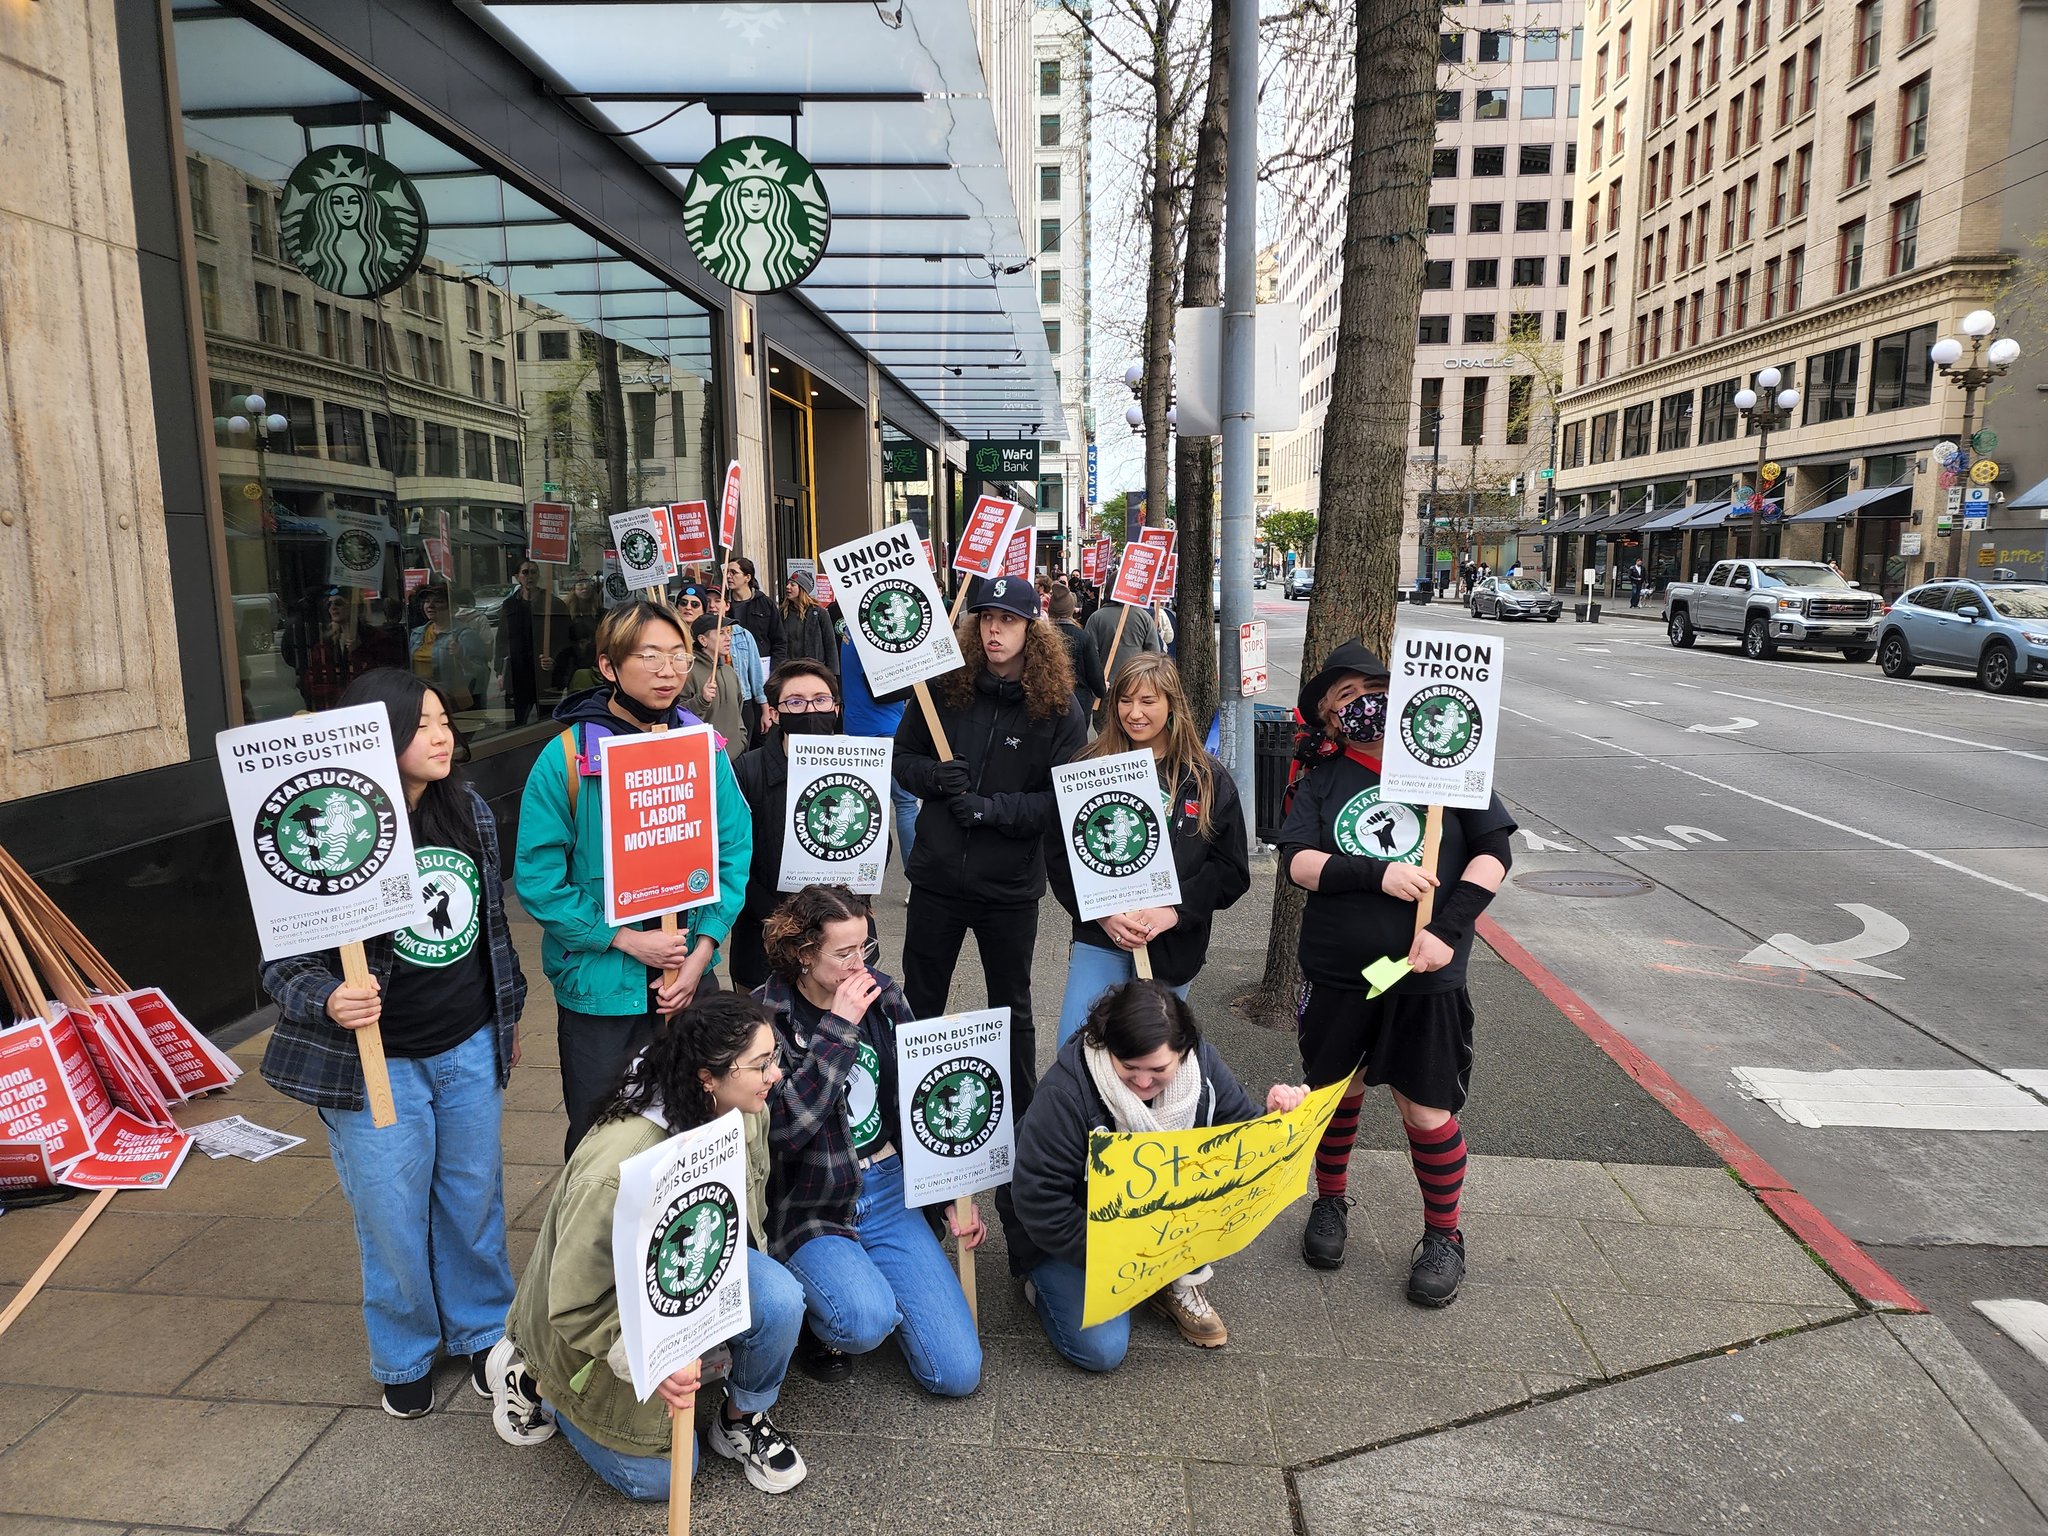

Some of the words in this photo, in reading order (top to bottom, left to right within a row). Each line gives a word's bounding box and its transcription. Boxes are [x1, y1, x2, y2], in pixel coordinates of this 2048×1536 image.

[1444, 358, 1514, 369] ORACLE
[1003, 449, 1032, 460] WaFd
[1004, 462, 1029, 472] Bank
[628, 513, 649, 521] BUSTING
[977, 512, 1005, 524] STARBUCKS
[984, 506, 1005, 514] DEMAND
[622, 529, 650, 542] STARBUCKS
[679, 532, 705, 540] MOVEMENT
[969, 535, 993, 546] EMPLOYEE
[974, 528, 995, 537] CUTTING
[622, 549, 639, 569] WORKER
[833, 533, 910, 574] UNION
[1129, 555, 1155, 565] STARBUCKS
[1134, 549, 1153, 558] DEMAND
[841, 553, 915, 589] STRONG
[1125, 573, 1149, 584] EMPLOYEE
[1129, 568, 1148, 576] CUTTING
[861, 580, 914, 610] STARBUCKS
[861, 621, 897, 652] WORKER
[900, 601, 931, 651] SOLIDARITY
[1244, 639, 1263, 652] STOPS
[1406, 640, 1492, 665] UNION
[874, 675, 884, 683] NO
[885, 667, 905, 678] UNION
[905, 658, 934, 672] BUSTING!
[1404, 662, 1489, 682] STRONG
[1412, 686, 1475, 711] STARBUCKS
[233, 736, 296, 757] UNION
[302, 721, 380, 746] BUSTING
[796, 745, 834, 755] UNION
[838, 747, 886, 756] BUSTING
[1402, 718, 1429, 763] WORKER
[1432, 722, 1481, 767] SOLIDARITY
[238, 760, 255, 773] IS
[262, 736, 381, 770] DISGUSTING!
[796, 757, 807, 765] IS
[811, 758, 884, 767] DISGUSTING!
[625, 763, 685, 790] REBUILD
[688, 762, 697, 778] A
[1059, 769, 1096, 783] UNION
[1099, 759, 1148, 776] BUSTING
[1063, 784, 1073, 794] IS
[1076, 770, 1149, 792] DISGUSTING!
[265, 771, 374, 814] STARBUCKS
[629, 782, 694, 810] FIGHTING
[806, 775, 873, 799] STARBUCKS
[640, 804, 686, 829] LABOR
[1078, 793, 1144, 822] STARBUCKS
[624, 820, 702, 852] MOVEMENT
[796, 811, 824, 858] WORKER
[827, 812, 880, 860] SOLIDARITY
[257, 834, 322, 892] WORKER
[327, 810, 394, 893] SOLIDARITY
[1074, 835, 1111, 875] WORKER
[1115, 822, 1158, 875] SOLIDARITY
[632, 888, 660, 899] Kshama
[661, 882, 685, 894] Sawant
[1095, 893, 1117, 902] UNION
[272, 924, 289, 934] NO
[292, 917, 328, 930] UNION
[331, 903, 378, 922] BUSTING!
[288, 910, 320, 920] PETITION
[273, 932, 303, 940] Connect
[304, 927, 319, 935] with
[340, 919, 361, 927] Twitter
[394, 929, 446, 957] ORKERS
[904, 1031, 947, 1047] UNION
[952, 1020, 1003, 1040] BUSTING
[907, 1049, 918, 1059] IS
[923, 1031, 1001, 1057] DISGUSTING!
[178, 1070, 206, 1085] DEMA
[921, 1060, 992, 1093] STARBUCKS
[0, 1095, 47, 1124] CUTTIN
[8, 1113, 42, 1137] STOP
[912, 1108, 950, 1155] WORKER
[954, 1090, 1001, 1155] SOLIDARITY
[113, 1137, 173, 1146] FIGHTING
[116, 1145, 161, 1155] LABOR
[95, 1151, 172, 1163] MOVEMENT
[656, 1156, 686, 1192] UNION
[691, 1128, 739, 1165] BUSTING
[664, 1145, 739, 1198] DISGUSTING!
[914, 1183, 925, 1191] NO
[927, 1177, 952, 1188] UNION
[953, 1168, 987, 1182] BUSTING!
[654, 1184, 728, 1240] STARBUCKS
[1151, 1221, 1200, 1245] You
[647, 1261, 681, 1315] WORKER
[685, 1217, 737, 1312] SOLIDARITY
[683, 1314, 716, 1342] BUSTING!
